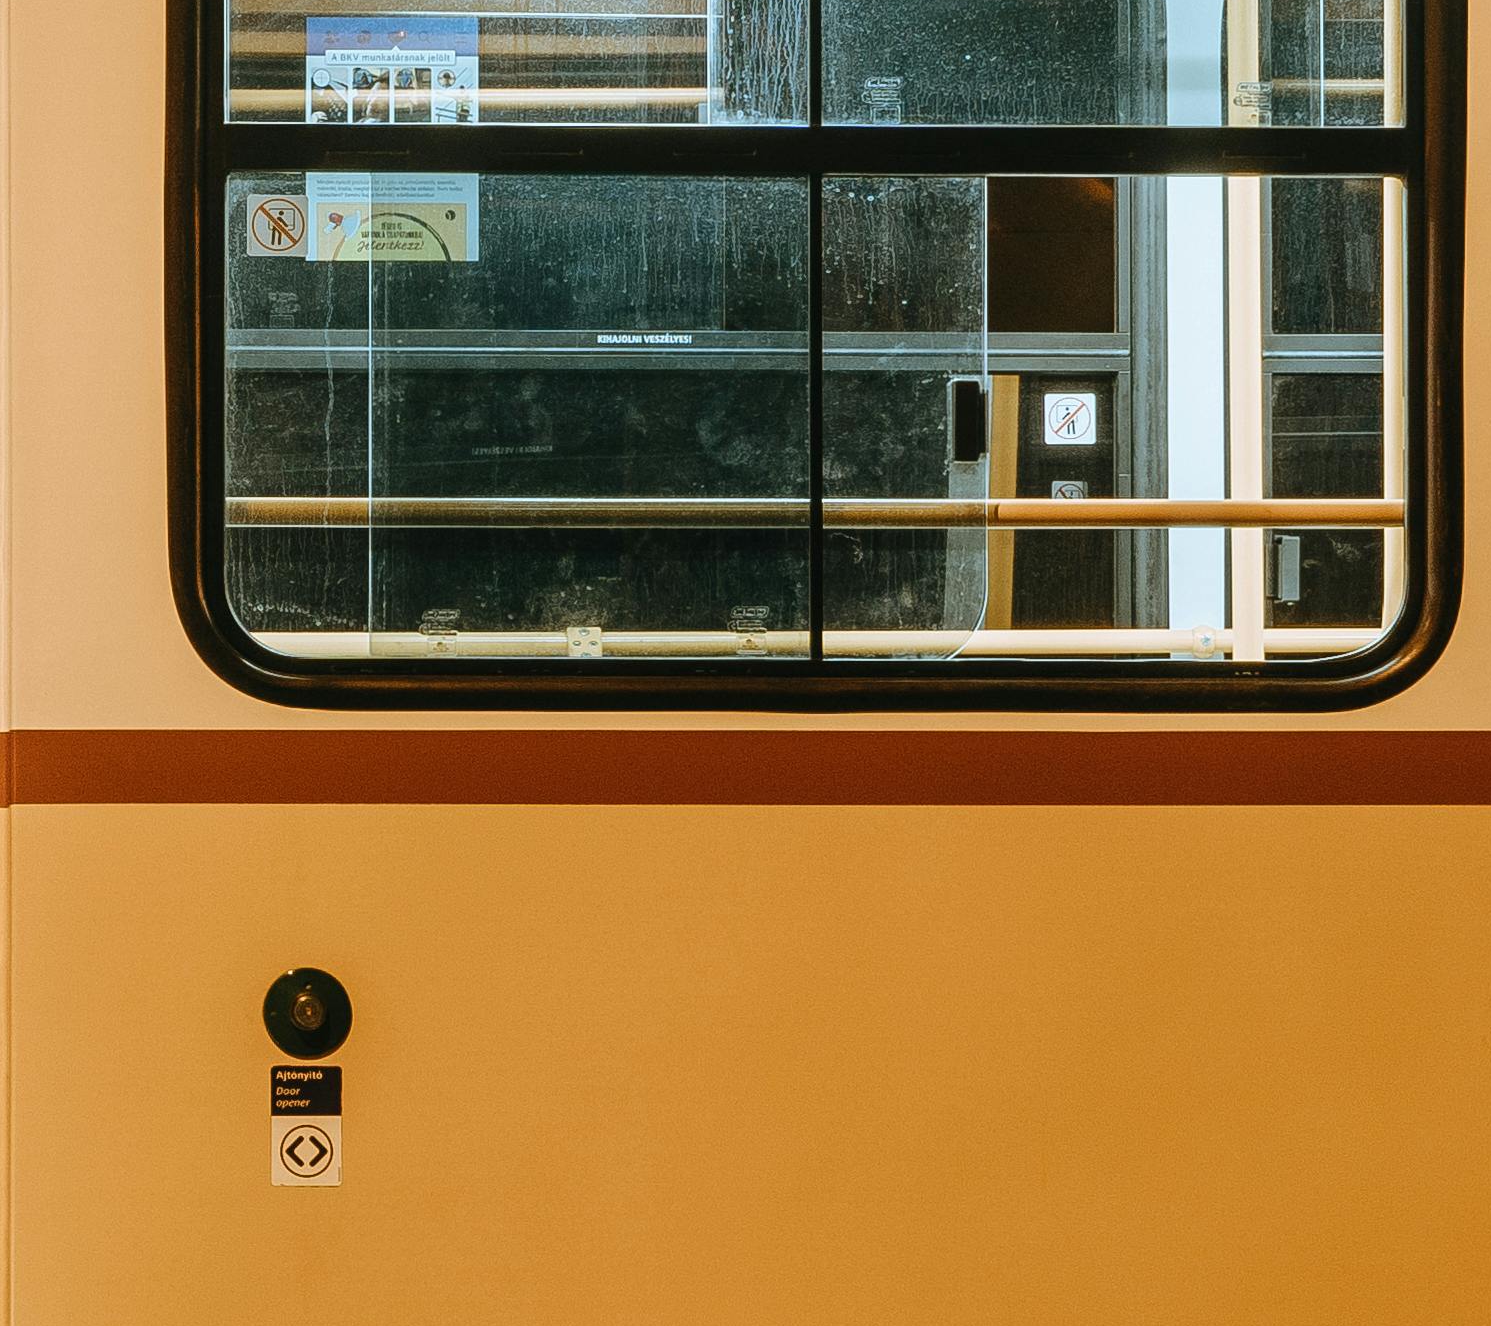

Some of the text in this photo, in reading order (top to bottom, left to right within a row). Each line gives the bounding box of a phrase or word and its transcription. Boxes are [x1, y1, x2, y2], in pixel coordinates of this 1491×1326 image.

[276, 1070, 324, 1082] Ajtónyító
[275, 1085, 302, 1096] Door
[275, 1099, 312, 1110] opener
